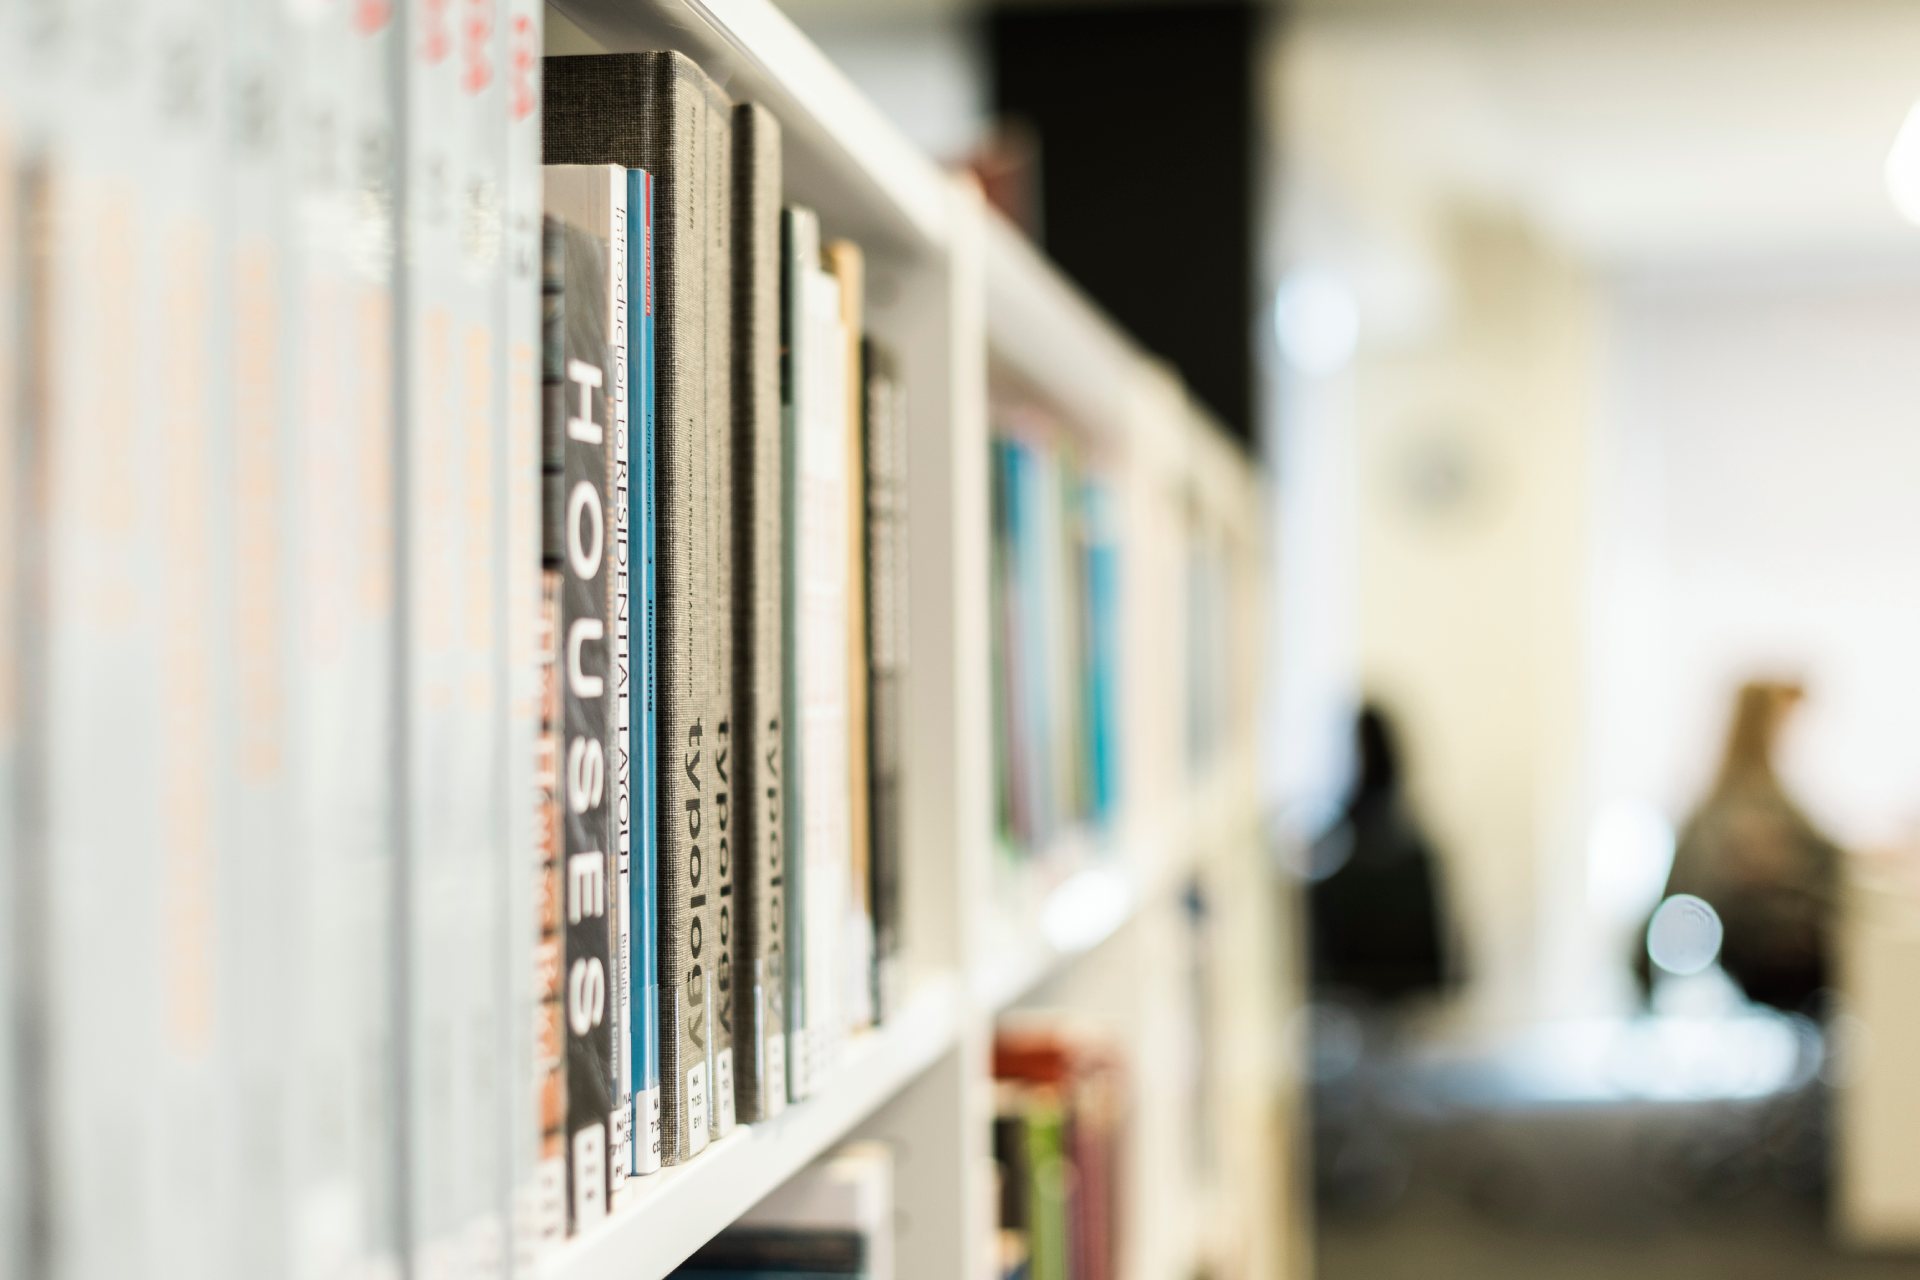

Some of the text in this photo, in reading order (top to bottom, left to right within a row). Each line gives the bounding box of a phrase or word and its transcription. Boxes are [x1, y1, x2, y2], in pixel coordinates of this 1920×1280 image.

[566, 358, 605, 1036] HOUSES
[615, 207, 629, 1007] Introduction to RESIDENTIAL LAYOUT Biddulph
[685, 717, 707, 1053] typology
[716, 716, 733, 1034] typology
